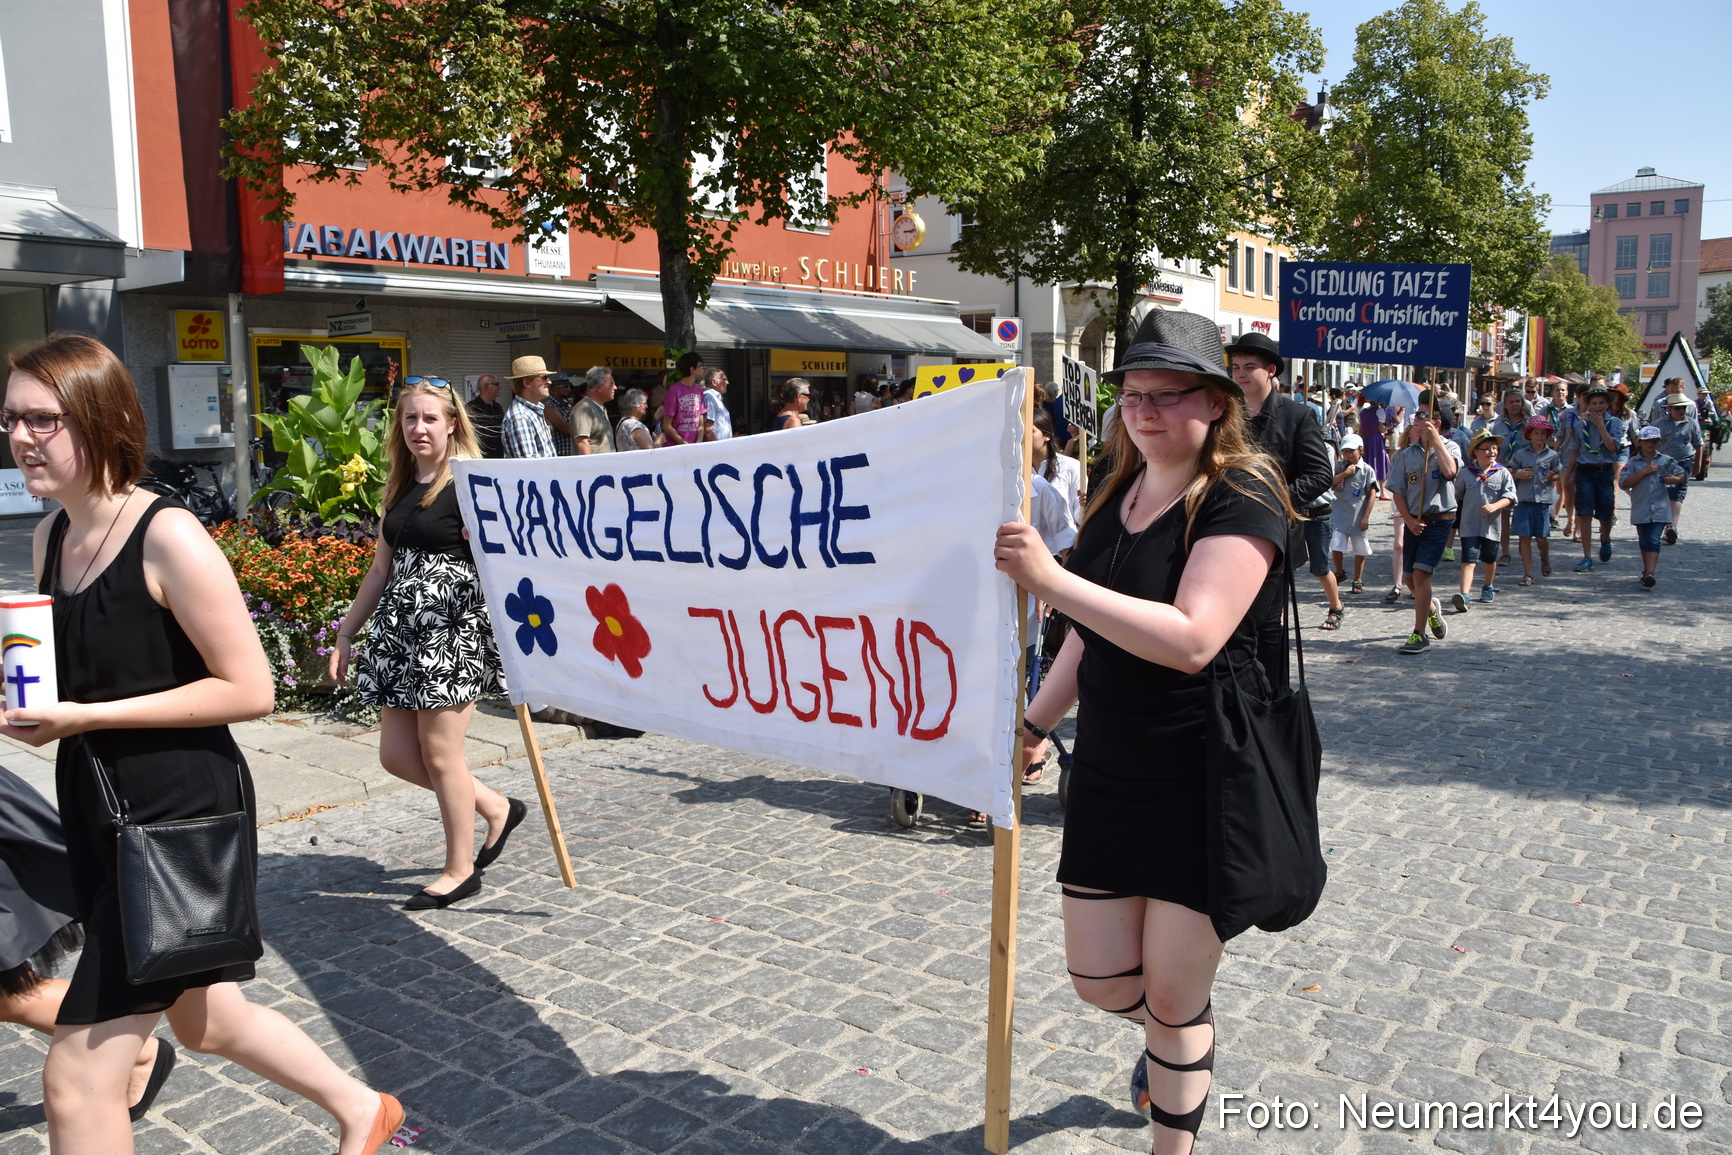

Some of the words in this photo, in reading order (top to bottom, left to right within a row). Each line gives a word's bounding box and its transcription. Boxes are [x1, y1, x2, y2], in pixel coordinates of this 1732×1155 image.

[283, 221, 510, 269] TABAKWAREN
[534, 258, 566, 270] THUMANN
[798, 256, 917, 292] SCHLIERF
[1292, 268, 1385, 297] SIEDLUNG
[1391, 265, 1450, 299] TAIZÉ
[329, 320, 344, 332] NZ
[480, 320, 489, 328] 41
[1290, 299, 1356, 323] Verband
[1361, 301, 1459, 327] Christlicher
[182, 338, 219, 349] LOTTO
[1316, 326, 1419, 355] Pfadfinder
[604, 356, 666, 369] SCHLIERF
[802, 361, 847, 371] SCHLIERF
[1062, 356, 1081, 385] TOD
[1063, 378, 1081, 403] UND
[1065, 399, 1096, 435] STERBEN
[468, 453, 876, 570] EVANGELISCHE
[687, 606, 957, 741] JUGEND
